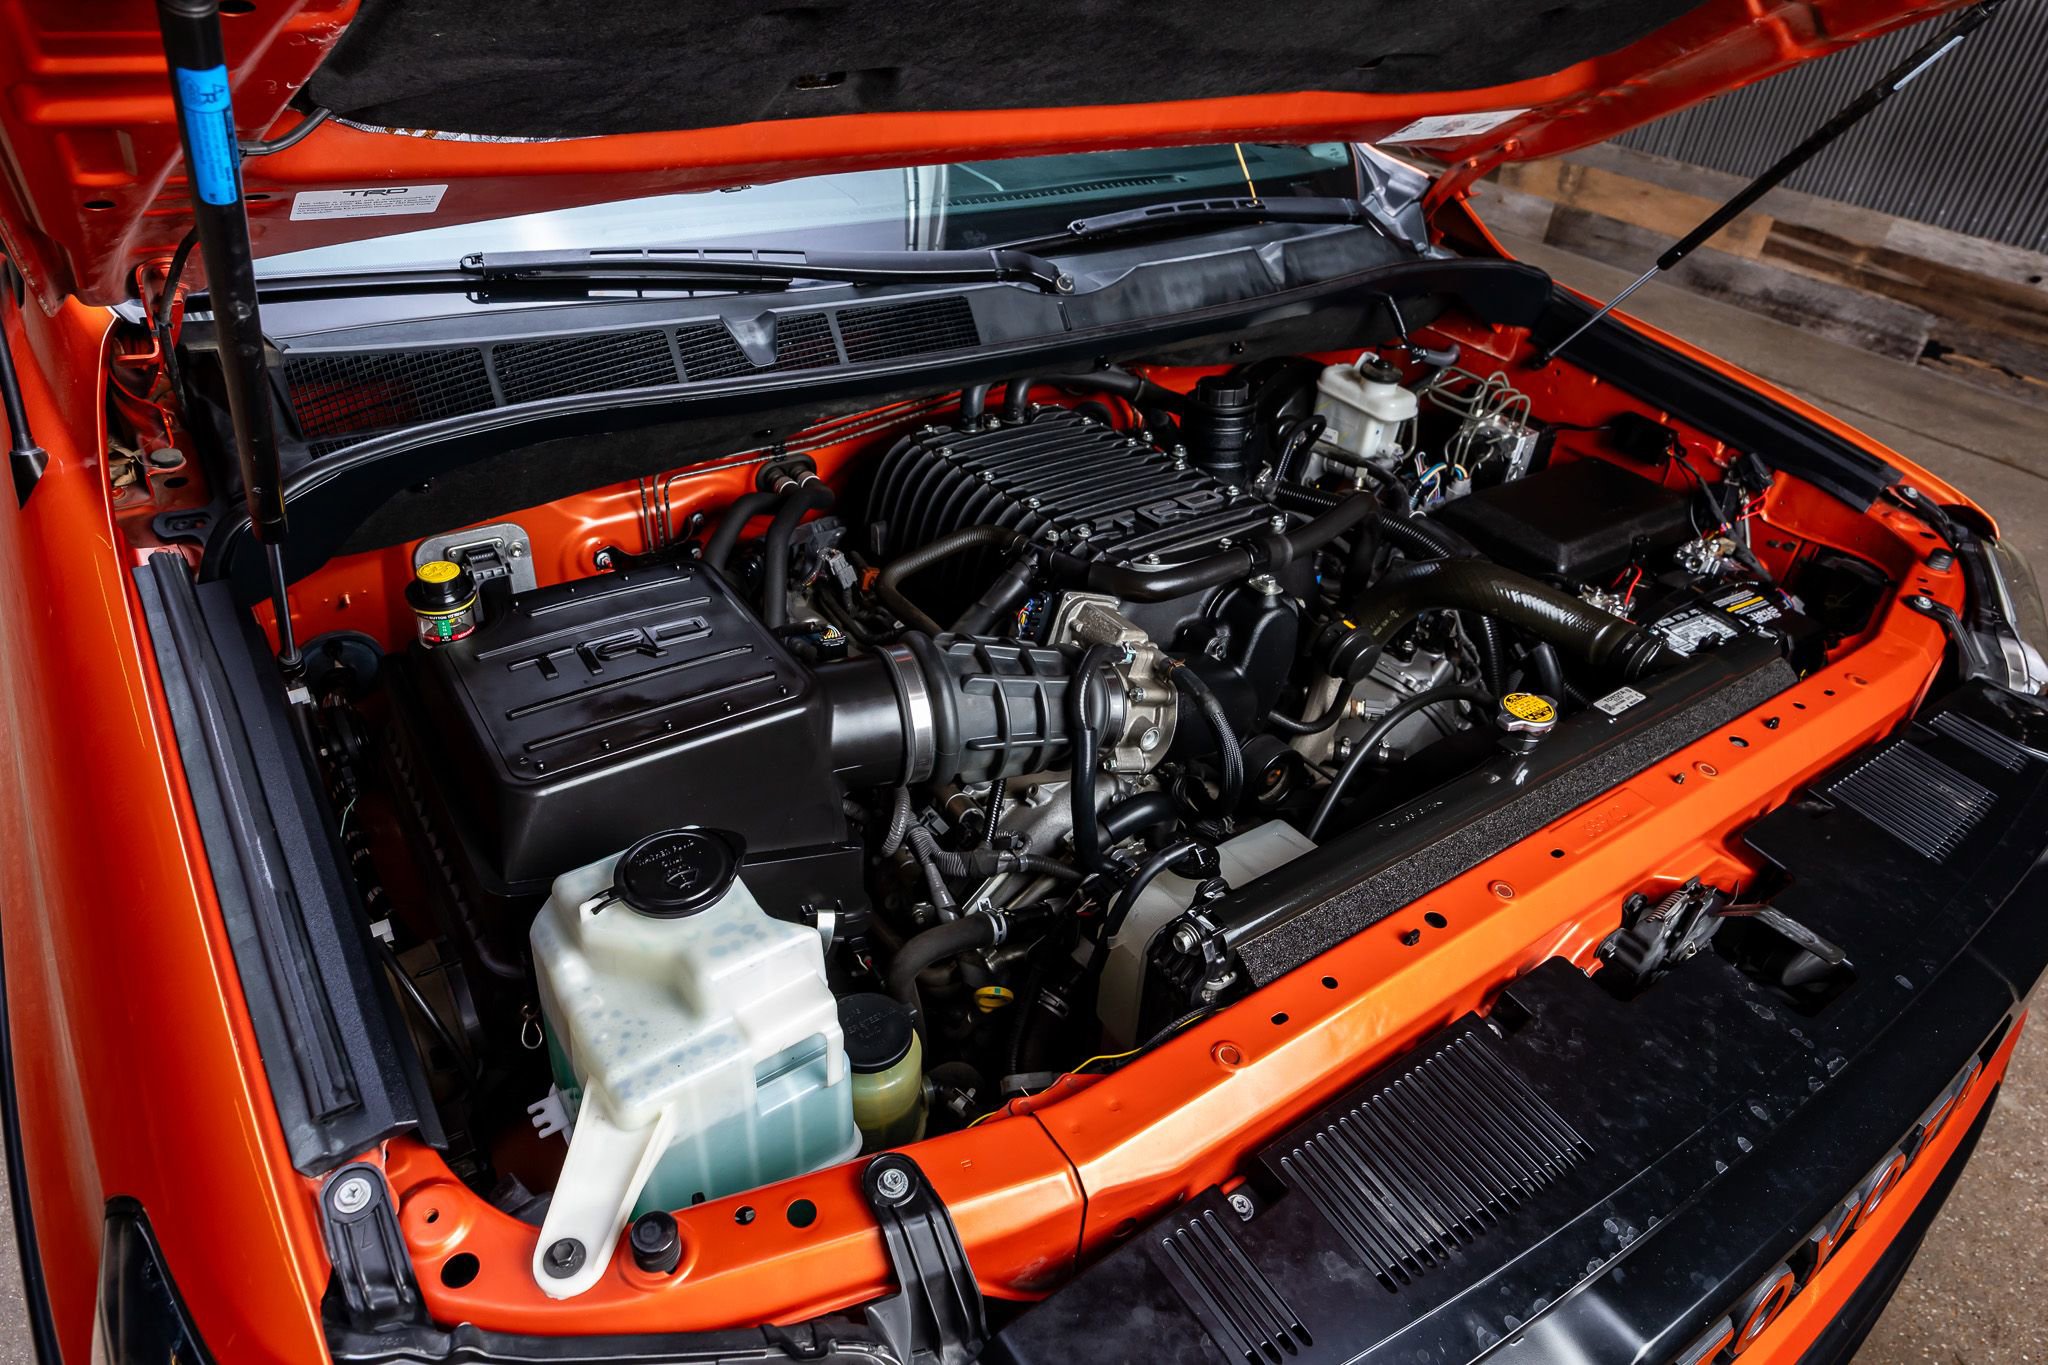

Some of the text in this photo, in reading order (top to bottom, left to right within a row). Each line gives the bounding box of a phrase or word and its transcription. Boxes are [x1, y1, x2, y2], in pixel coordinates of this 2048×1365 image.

[343, 188, 409, 197] TRD
[1092, 490, 1225, 536] TRD
[508, 616, 713, 680] TRD
